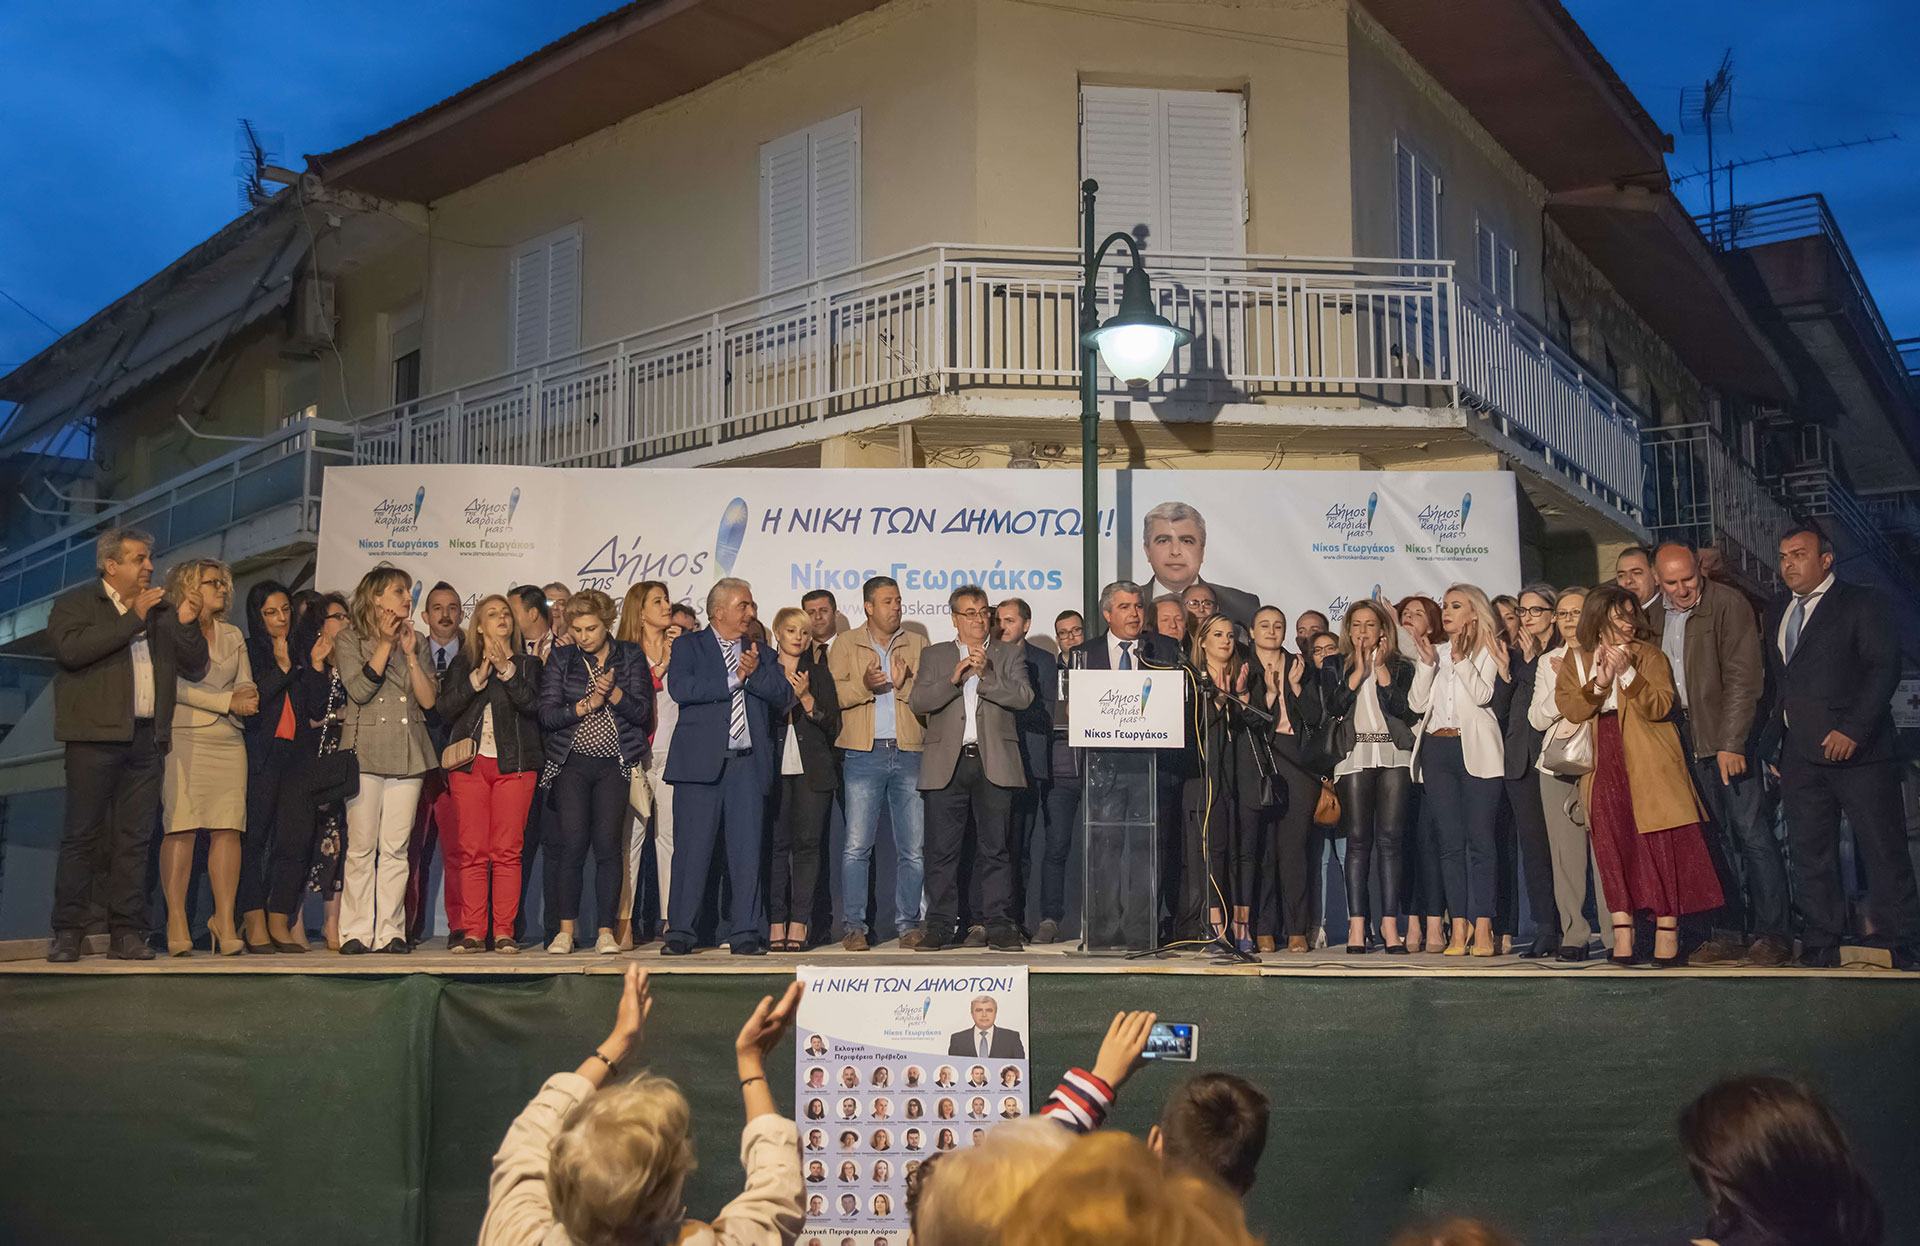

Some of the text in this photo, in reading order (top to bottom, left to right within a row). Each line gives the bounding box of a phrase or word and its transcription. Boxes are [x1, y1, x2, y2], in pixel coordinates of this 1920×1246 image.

[374, 499, 413, 517] Δήμος
[464, 498, 507, 517] Δήμος
[1326, 504, 1366, 522] Δήμος
[1418, 505, 1460, 523] Δήμος
[375, 513, 413, 529] καρδιάς
[466, 513, 507, 530] καρδιάς
[761, 507, 1115, 537] Η ΝΙΚΗ ΤΩΝ ΔΗΜΟΤΩ!
[1328, 517, 1367, 533] καρδιάς
[1420, 519, 1460, 535] καρδιάς
[358, 538, 439, 550] Νίκος Γεωργάκος
[449, 538, 535, 551] Νίκος Γεωργάκος
[1312, 542, 1396, 555] Νίκος Γεωργάκος
[1405, 544, 1489, 556] Νίκος Γεωργάκος
[577, 535, 708, 585] Δήμος
[1099, 689, 1140, 707] Δήμος
[1101, 703, 1140, 719] καρδιάς
[1084, 728, 1168, 741] Νίκος Γεωργάκος
[812, 977, 1013, 993] Η ΝΙΚΗ ΤΩΝ ΔΗΜΟΤΩΝ!
[834, 1044, 865, 1053] Εκλογική
[834, 1053, 908, 1061] Περιφέρεια Πρέβεζας
[829, 1228, 869, 1236] Περιφέρεια
[870, 1228, 898, 1236] Λούρου
